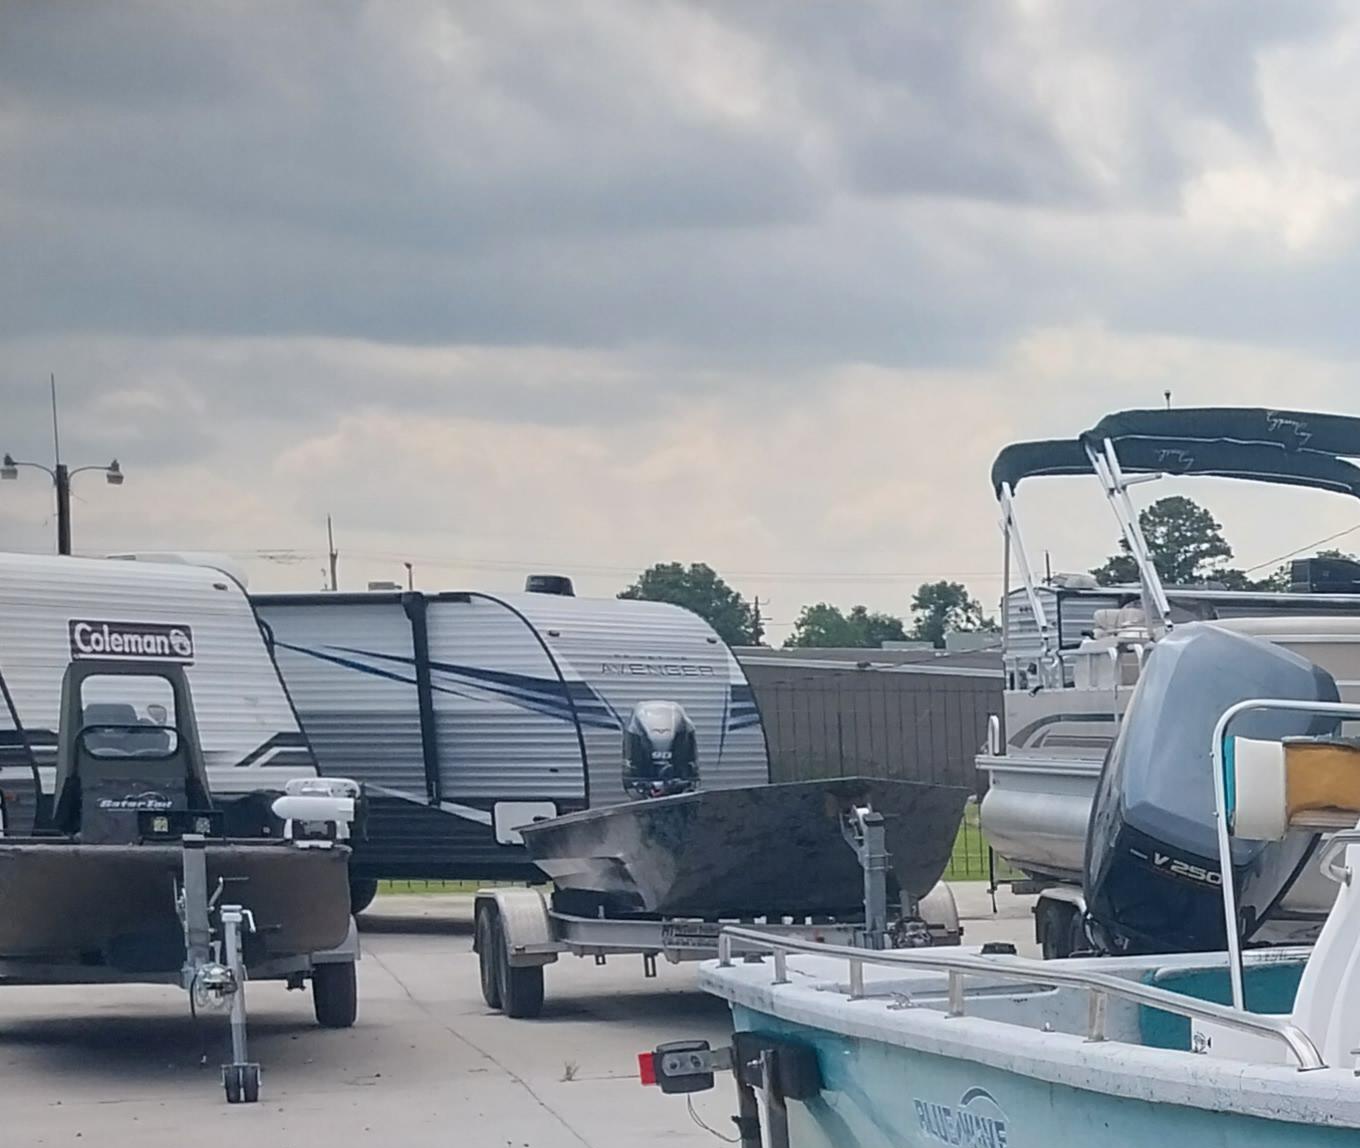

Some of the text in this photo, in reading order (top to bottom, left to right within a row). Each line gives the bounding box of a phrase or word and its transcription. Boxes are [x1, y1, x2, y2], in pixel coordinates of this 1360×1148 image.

[74, 622, 170, 654] Coleman
[602, 663, 713, 676] AVENGER
[651, 751, 673, 759] 90
[1154, 852, 1222, 885] V 250
[913, 1098, 960, 1146] BLUE
